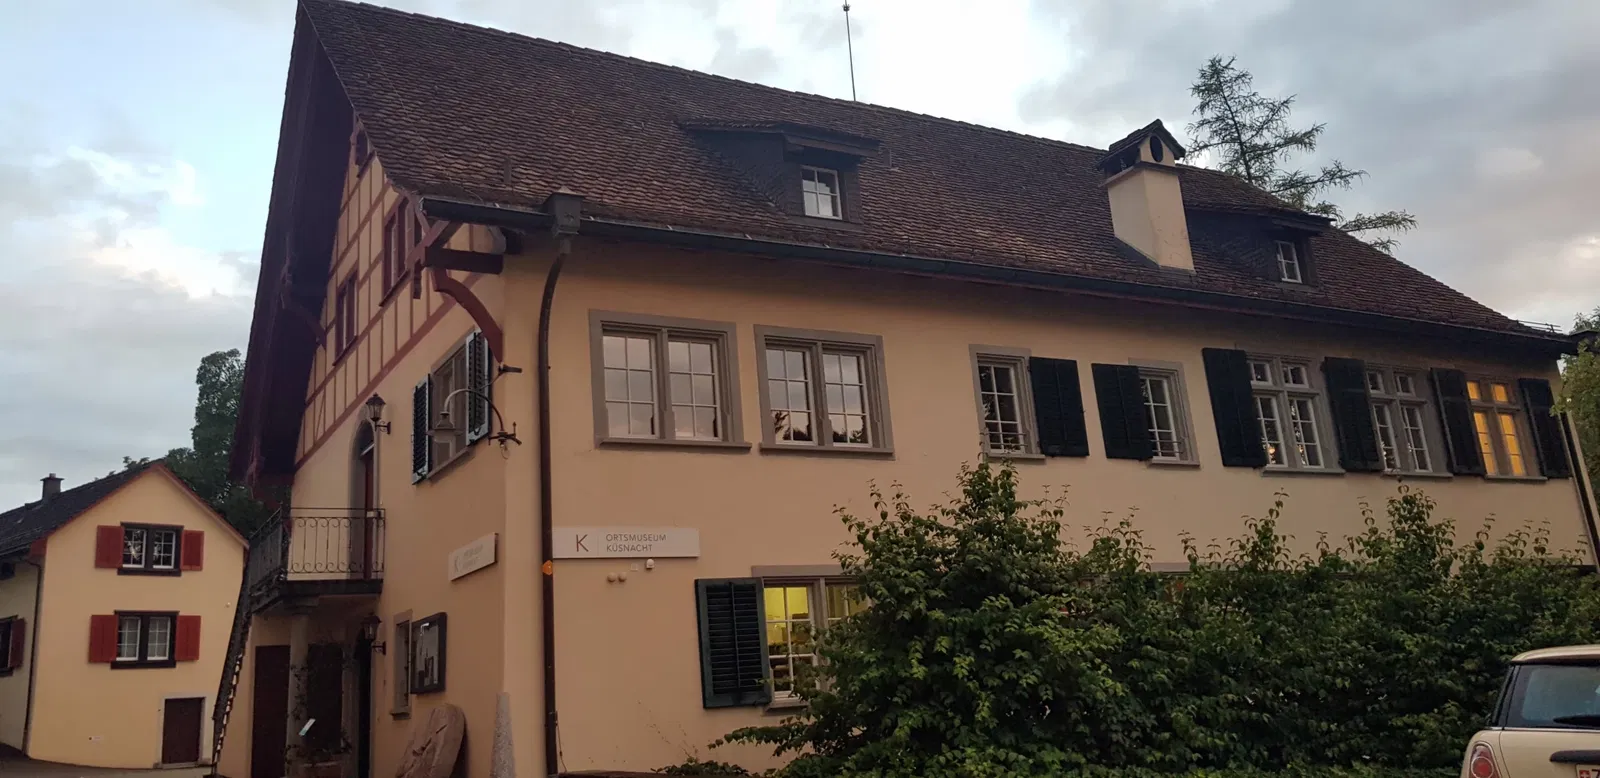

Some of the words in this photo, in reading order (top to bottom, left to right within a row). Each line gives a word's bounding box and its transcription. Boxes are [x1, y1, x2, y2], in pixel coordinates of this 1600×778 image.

[605, 533, 667, 542] ORTSMUSEUM
[575, 534, 589, 552] K
[606, 543, 653, 552] KÜSNACHT
